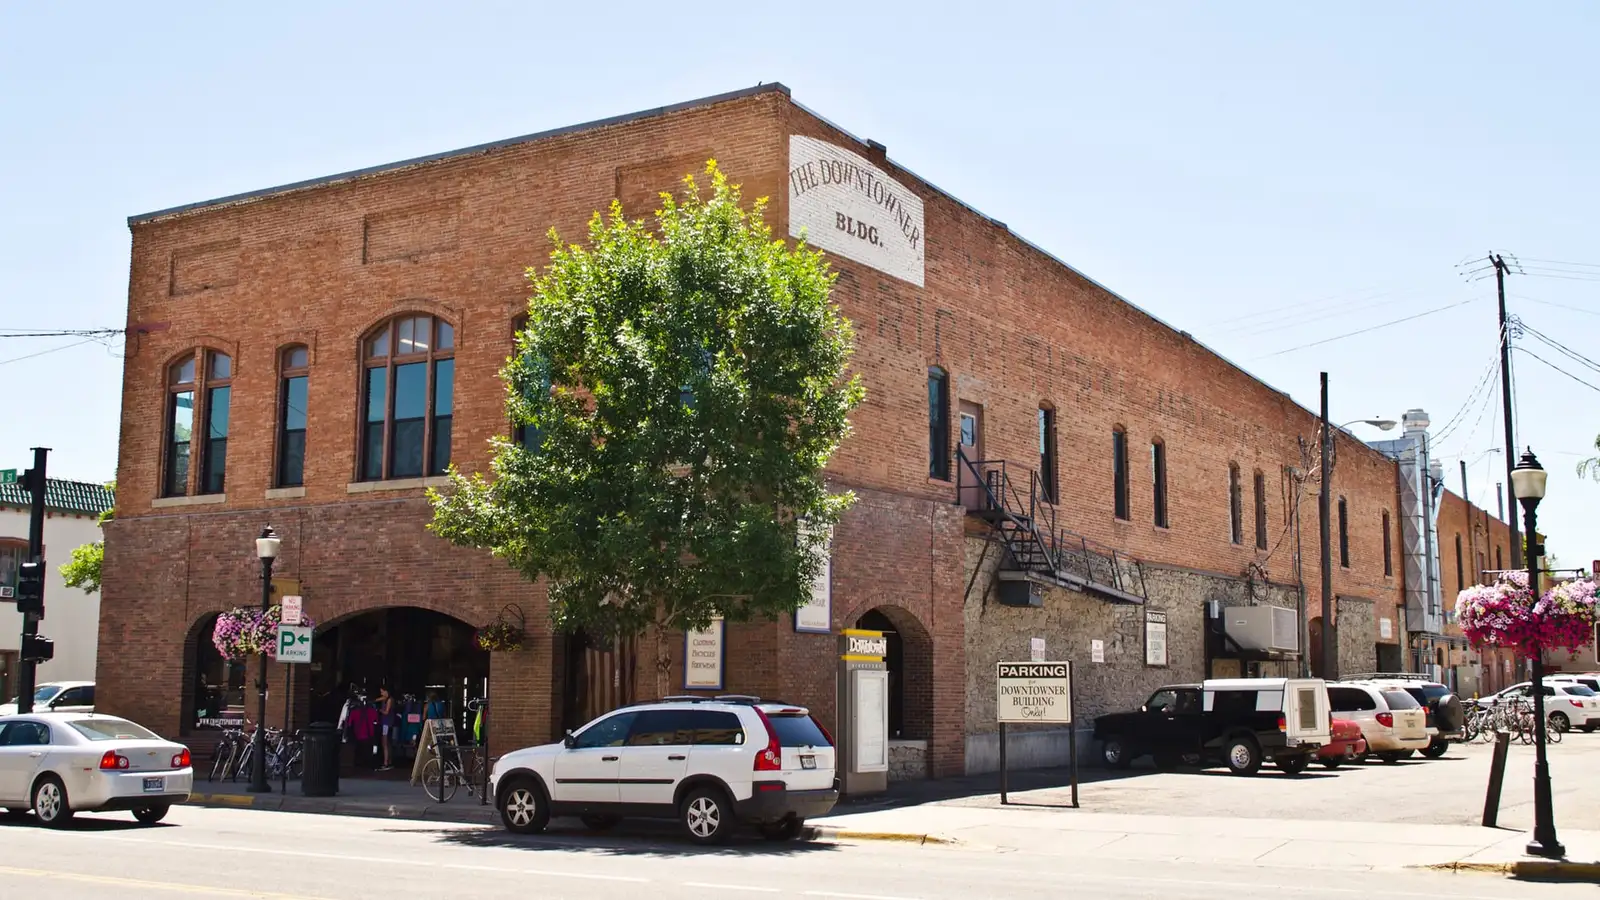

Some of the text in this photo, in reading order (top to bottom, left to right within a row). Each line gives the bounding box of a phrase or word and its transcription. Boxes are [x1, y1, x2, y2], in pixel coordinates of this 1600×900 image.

[790, 159, 920, 250] THE DOWNTOWNER
[835, 211, 884, 247] BLDG.
[1147, 613, 1166, 622] PARKING
[1000, 666, 1065, 677] PARKING
[1001, 686, 1066, 696] DOWNTOWNER
[1013, 696, 1054, 706] BUILDING
[1021, 706, 1046, 720] Only!
